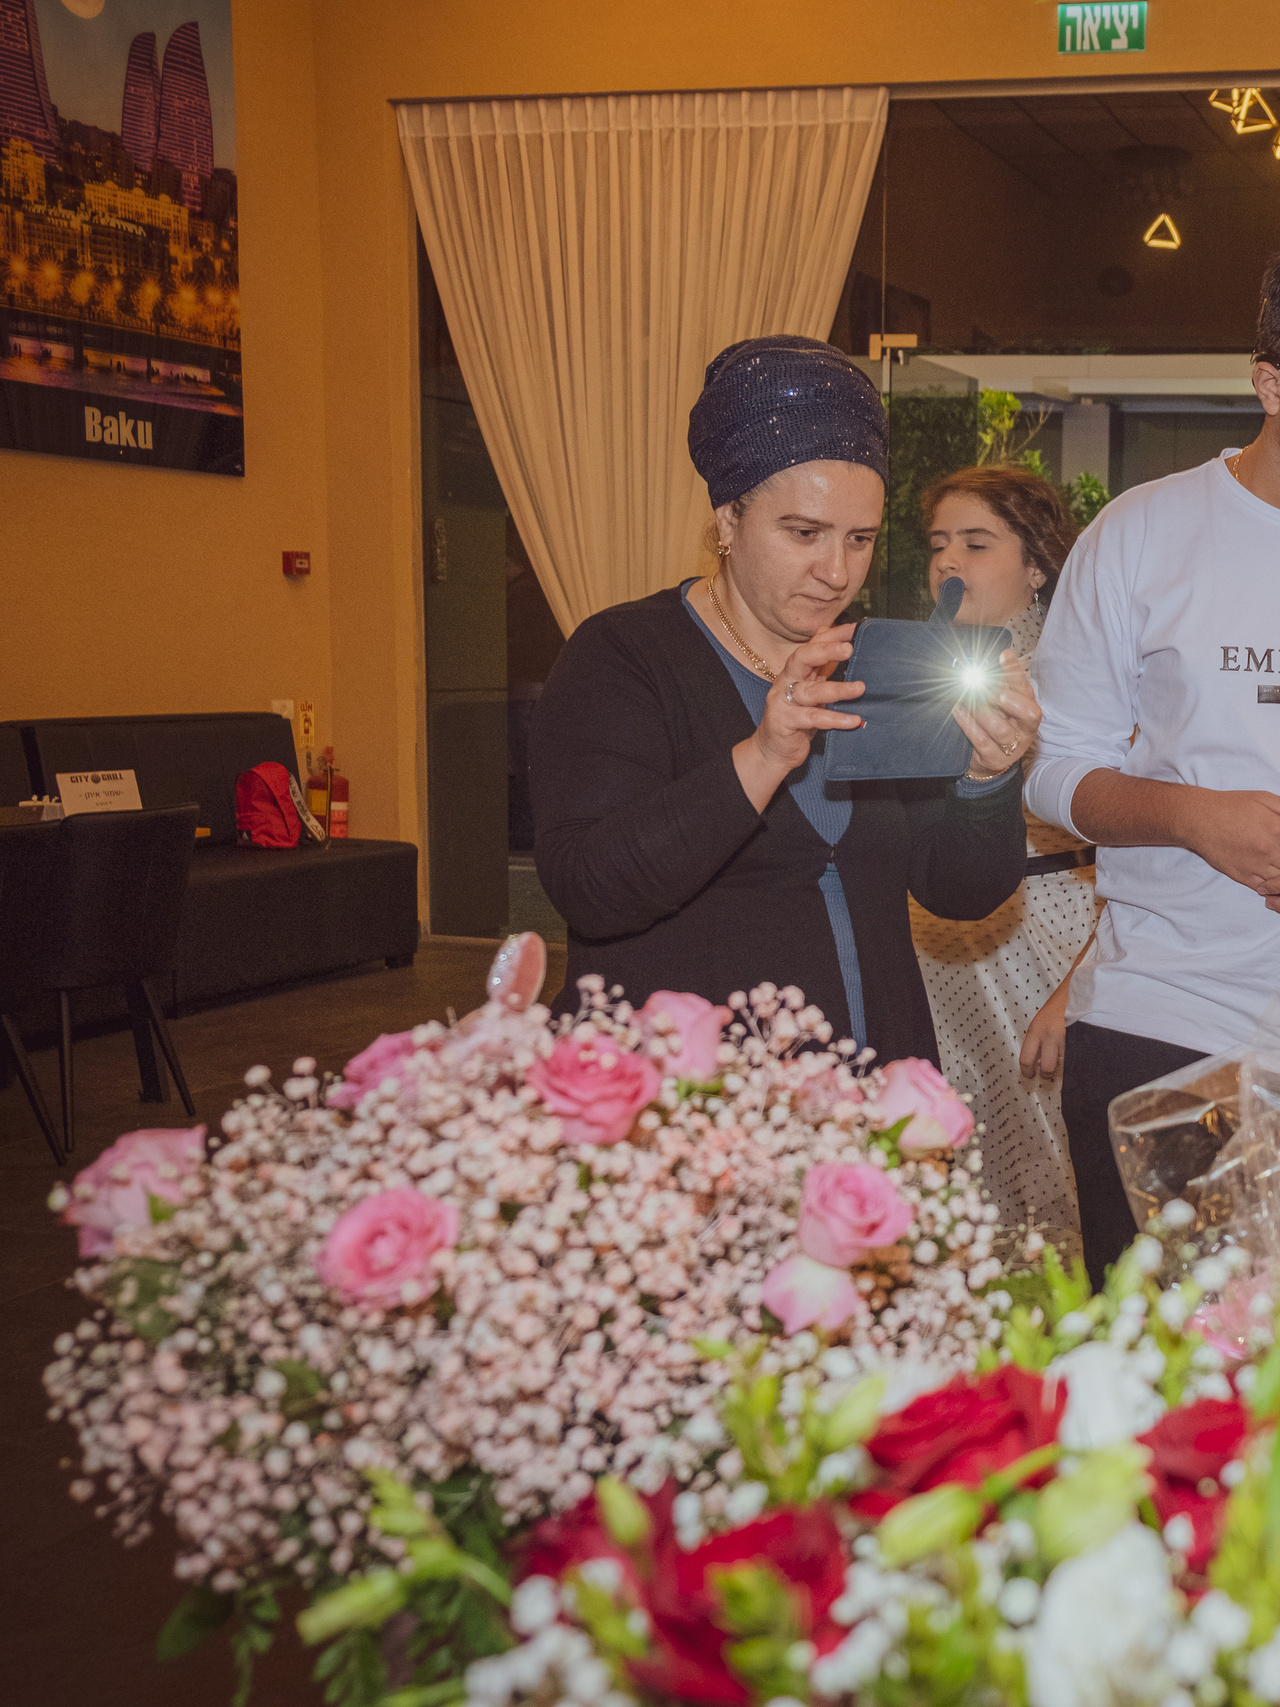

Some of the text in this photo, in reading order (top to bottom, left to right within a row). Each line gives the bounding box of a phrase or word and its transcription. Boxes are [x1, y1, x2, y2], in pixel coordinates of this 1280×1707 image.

[1065, 4, 1139, 51] יציאה
[84, 405, 153, 450] Baku
[70, 772, 124, 784] CITY GRILL
